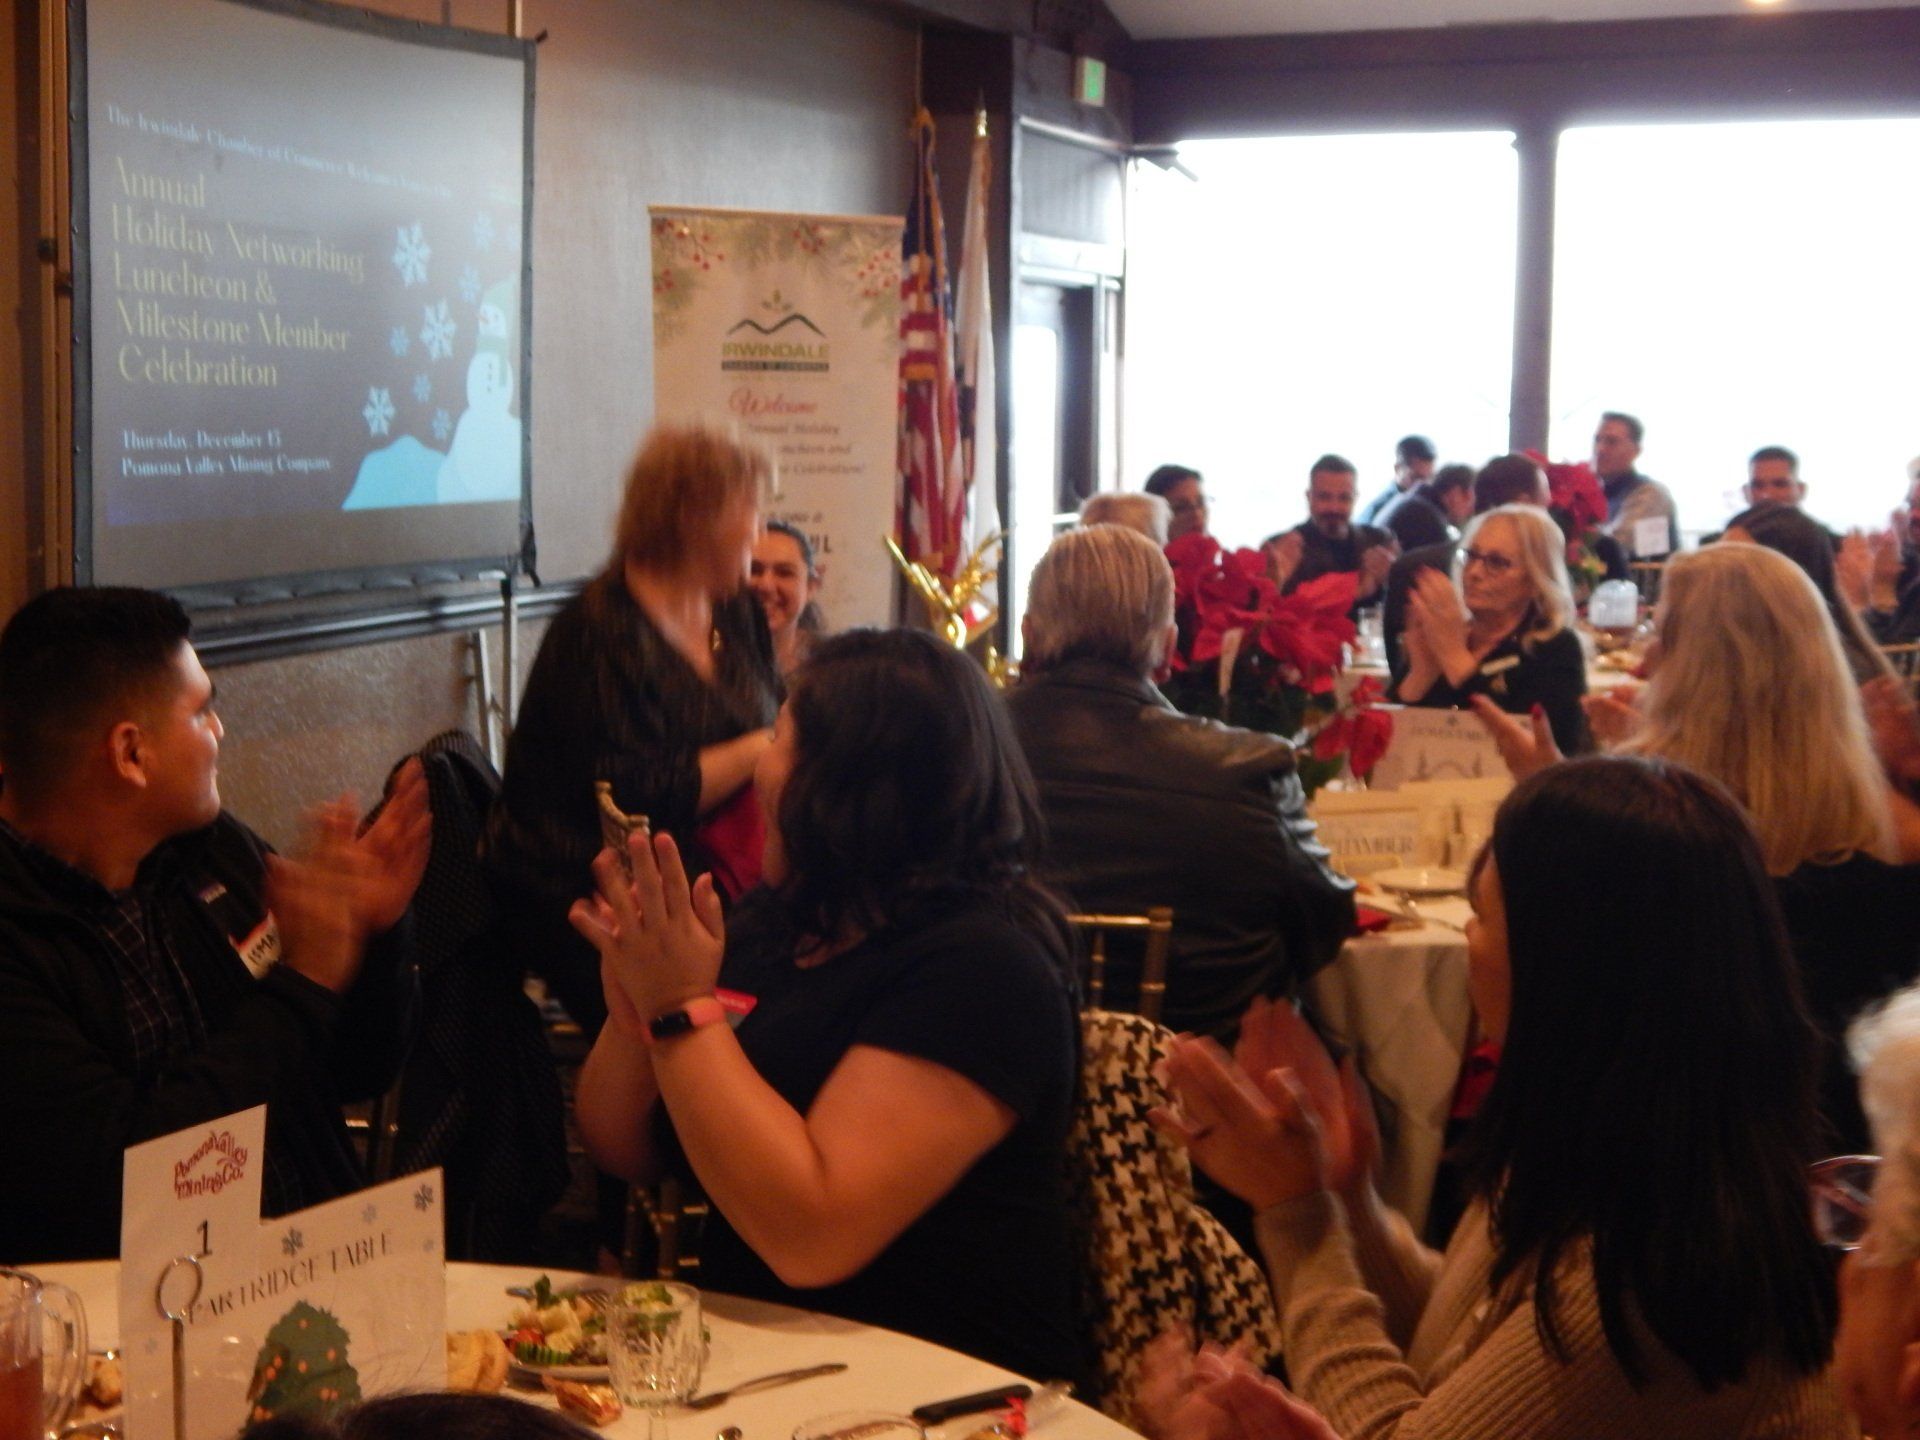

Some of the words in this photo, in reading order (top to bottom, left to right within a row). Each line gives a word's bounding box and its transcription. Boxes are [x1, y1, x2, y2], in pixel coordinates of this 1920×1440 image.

[117, 156, 206, 208] Annual
[112, 202, 214, 258] Holiday
[227, 221, 365, 284] Networking
[114, 251, 247, 301] Luncheon
[255, 270, 278, 305] &
[117, 299, 249, 345] Milestone
[258, 312, 350, 352] Member
[118, 343, 279, 388] Celebration
[723, 342, 830, 359] IRWINDALE
[196, 429, 262, 448] December
[121, 456, 182, 477] Pomona
[185, 454, 224, 475] Valley
[174, 1134, 215, 1188] Pomona
[210, 1130, 248, 1168] Valley
[177, 1173, 222, 1200] Mining
[197, 1219, 213, 1260] 1
[329, 1230, 392, 1275] TABLE
